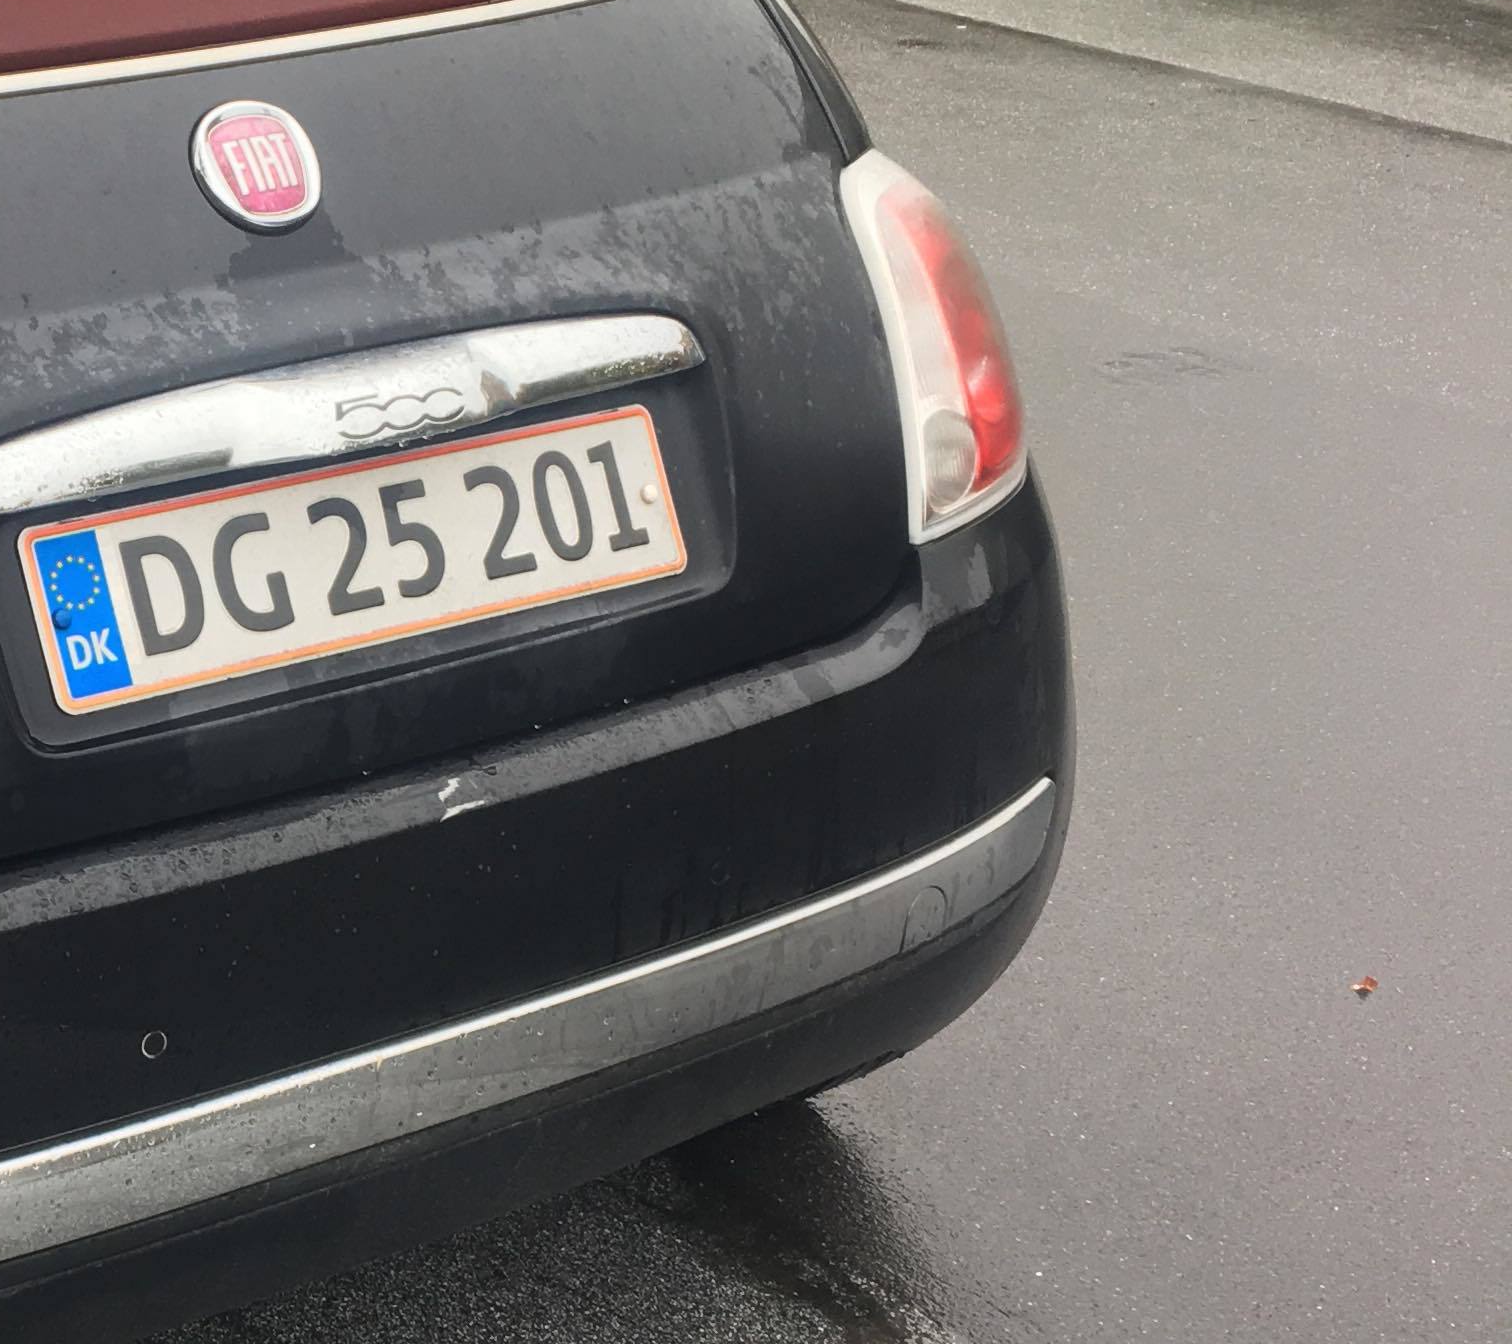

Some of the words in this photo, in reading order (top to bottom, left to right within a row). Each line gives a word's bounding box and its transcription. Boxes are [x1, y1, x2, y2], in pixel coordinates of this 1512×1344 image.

[222, 133, 299, 196] FIAT
[334, 387, 465, 440] 500
[118, 511, 296, 656] DG
[306, 479, 447, 617] 25
[462, 439, 651, 582] 201
[65, 627, 119, 671] DK
